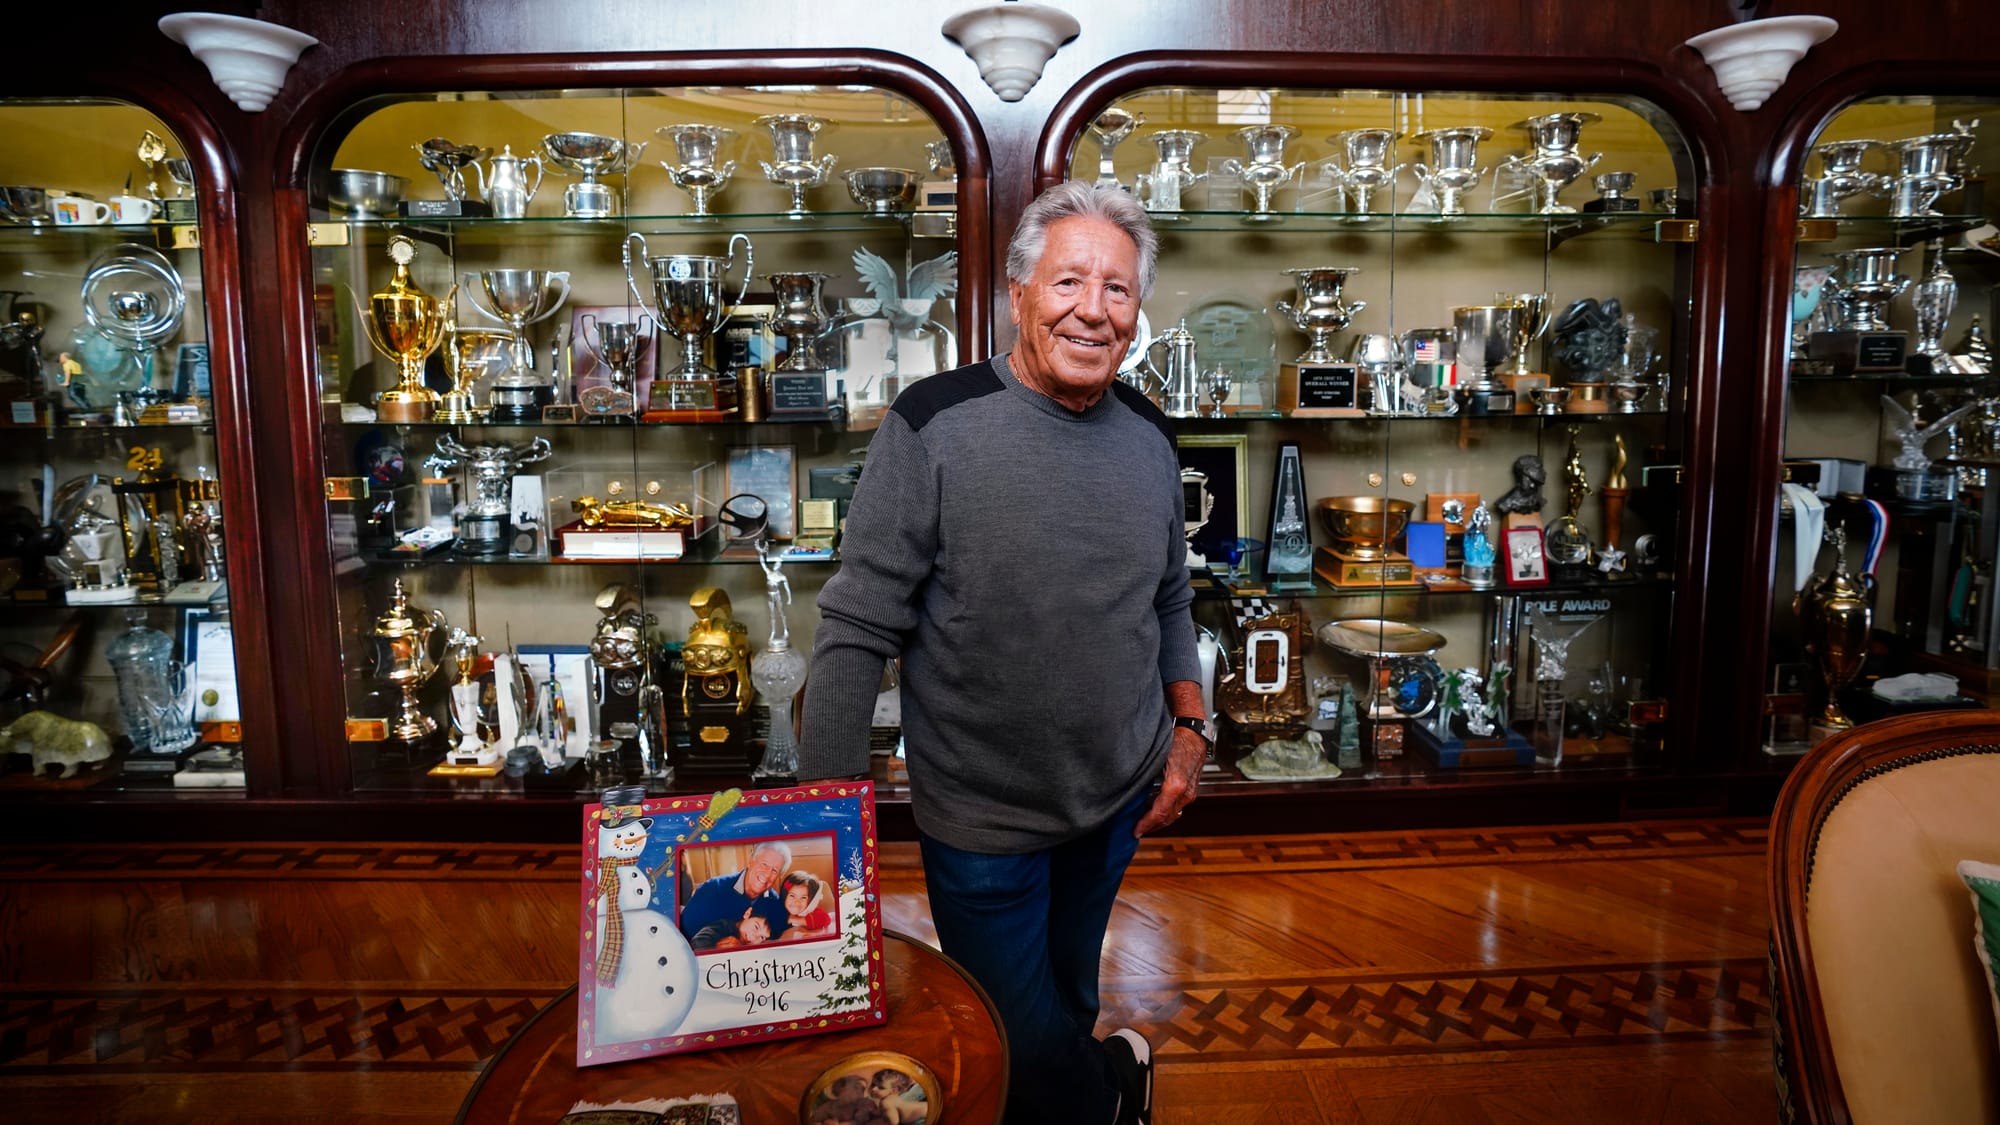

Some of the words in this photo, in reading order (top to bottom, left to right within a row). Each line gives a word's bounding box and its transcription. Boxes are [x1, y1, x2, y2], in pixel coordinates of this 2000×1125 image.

[127, 447, 162, 470] 24
[1525, 601, 1558, 613] POLE
[1561, 600, 1611, 611] AWARD
[706, 956, 826, 989] Christmas
[745, 990, 791, 1015] 2016
